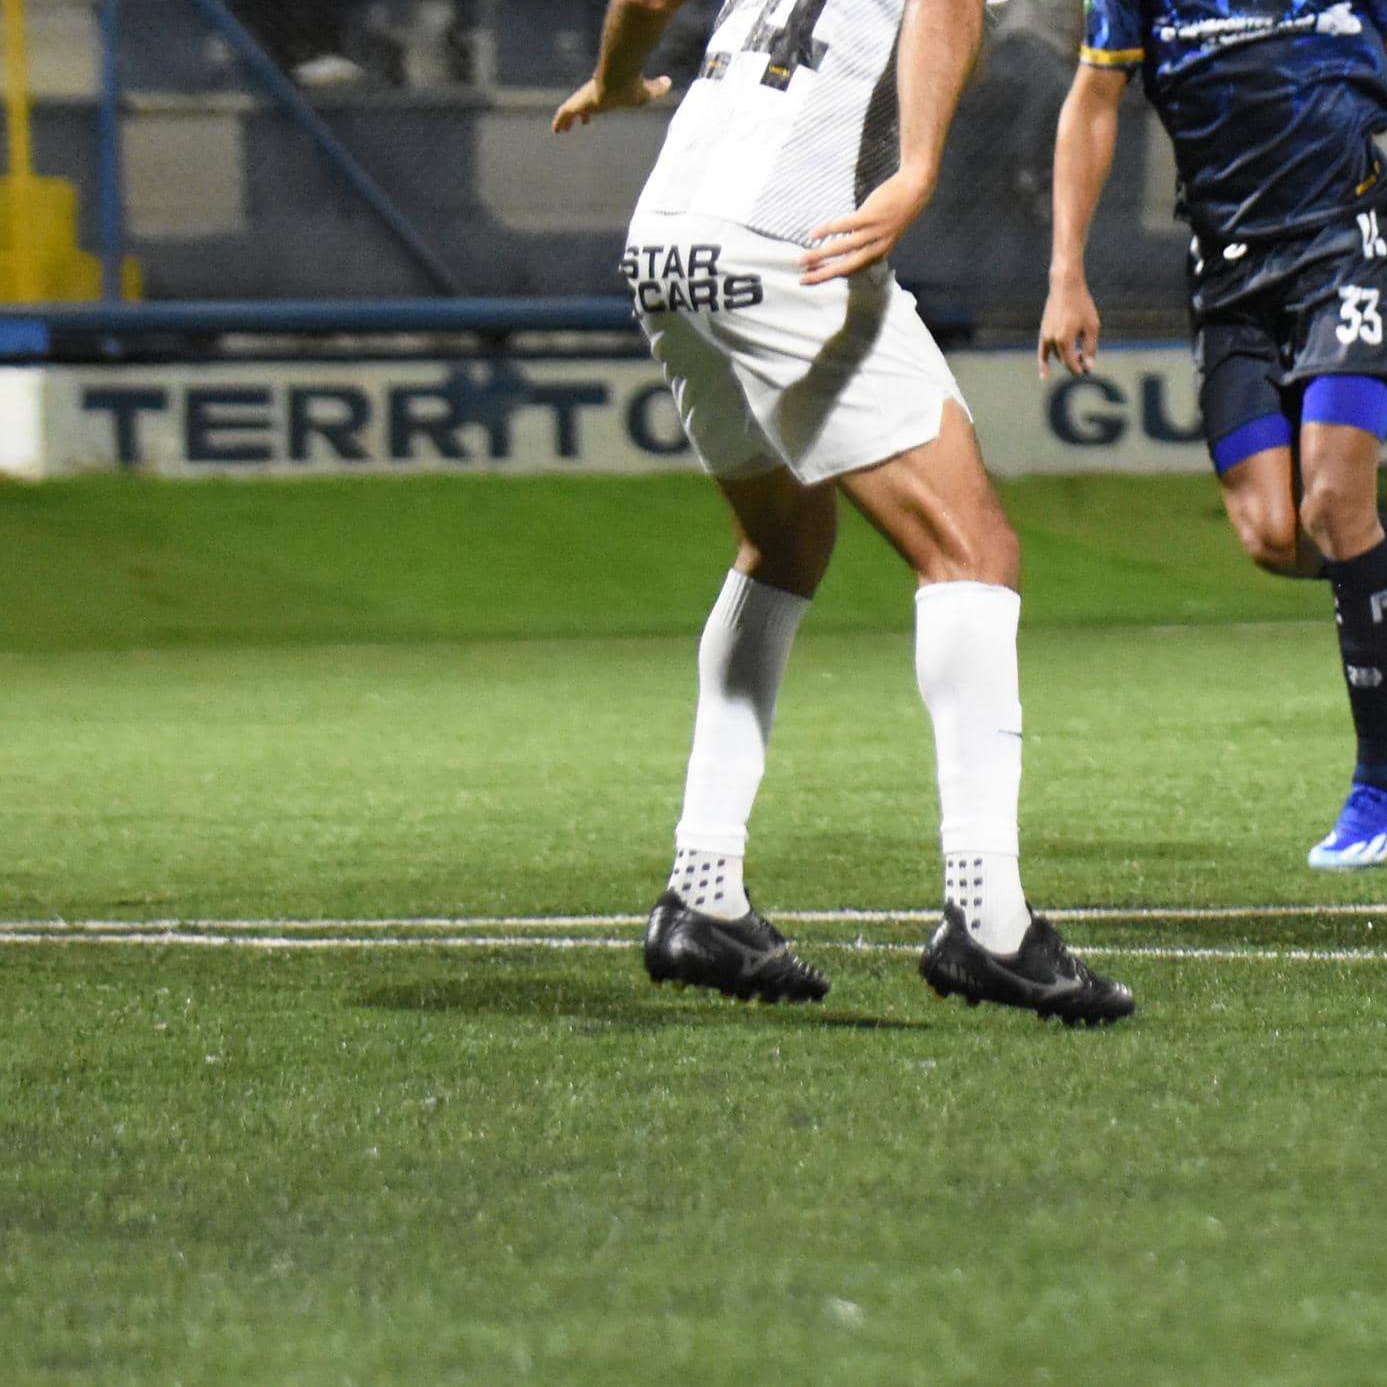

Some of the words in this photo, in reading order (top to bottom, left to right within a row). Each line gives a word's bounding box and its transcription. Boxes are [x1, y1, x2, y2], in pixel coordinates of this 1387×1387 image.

[622, 245, 720, 281] STAR
[637, 274, 763, 312] CARS
[1335, 284, 1384, 346] 33
